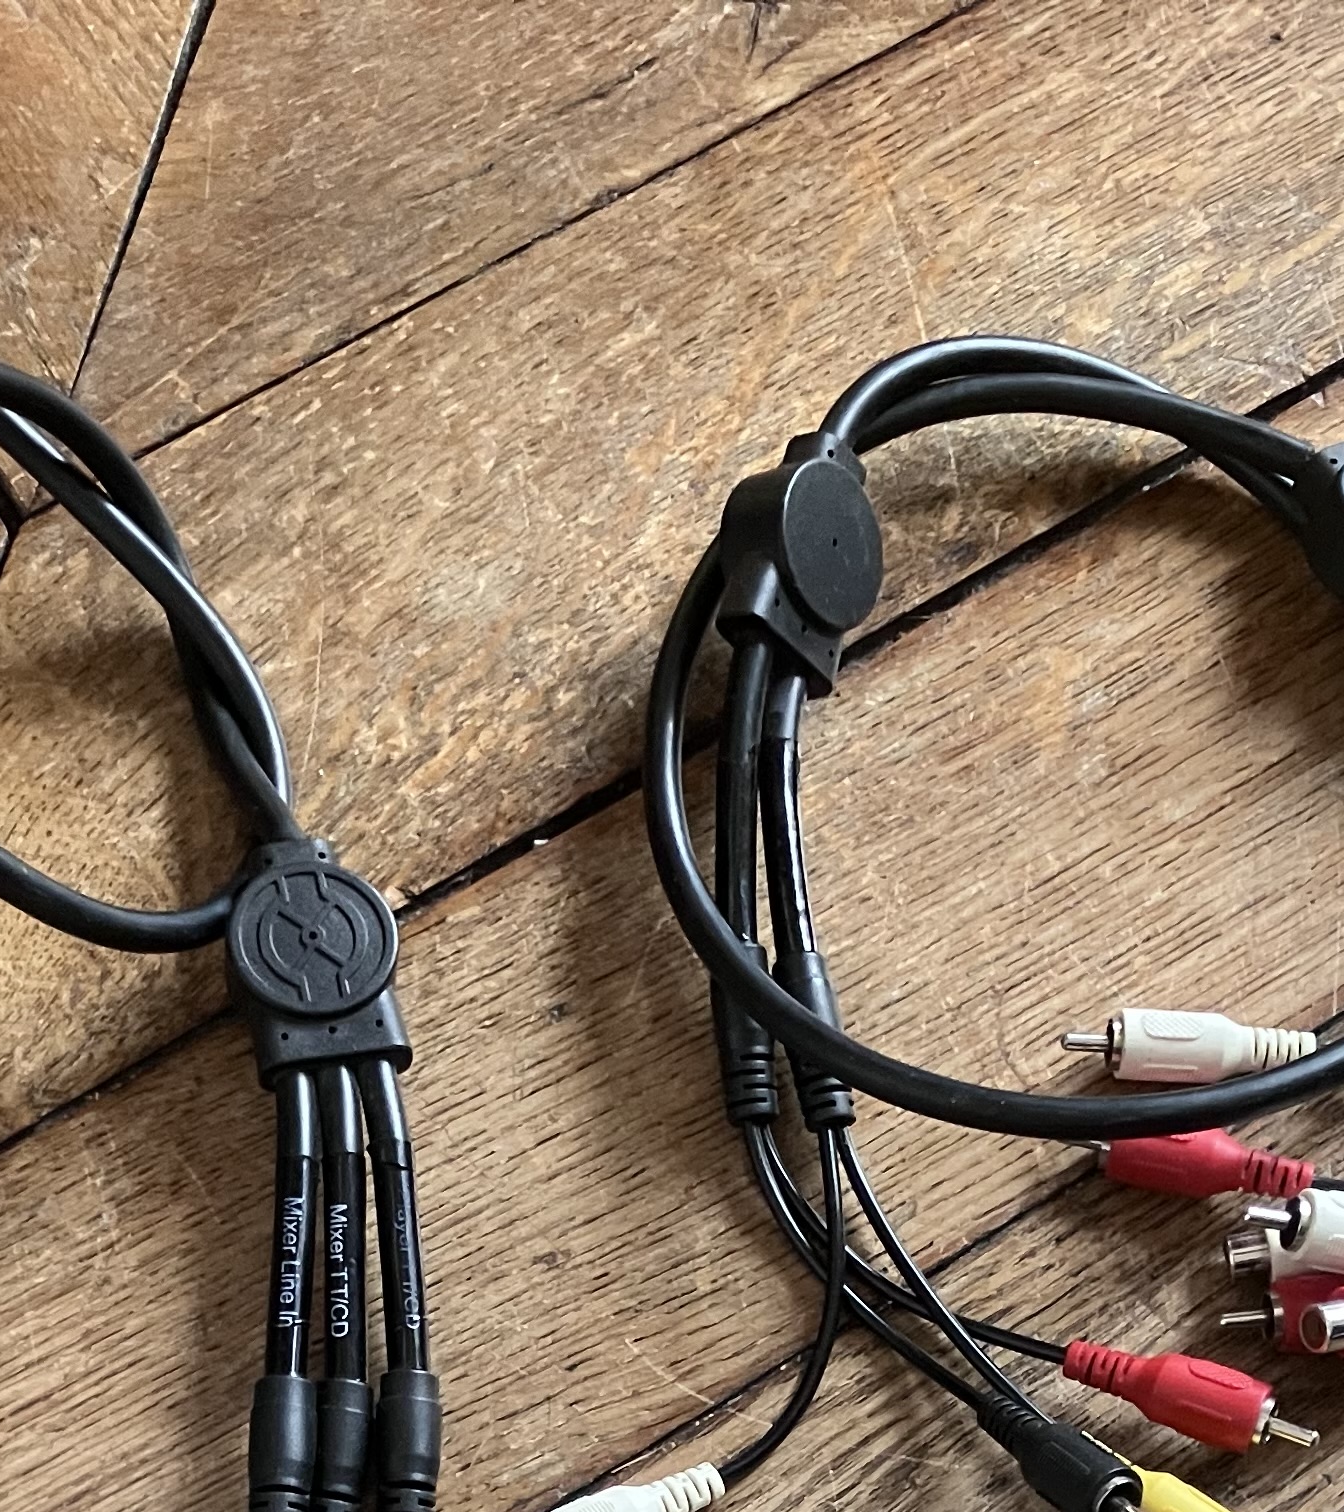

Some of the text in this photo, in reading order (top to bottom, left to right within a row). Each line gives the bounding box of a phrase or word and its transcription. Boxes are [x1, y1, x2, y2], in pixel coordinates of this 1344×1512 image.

[282, 1196, 306, 1253] Mixer
[279, 1258, 302, 1304] Line
[329, 1203, 349, 1338] Mixer TT/CD
